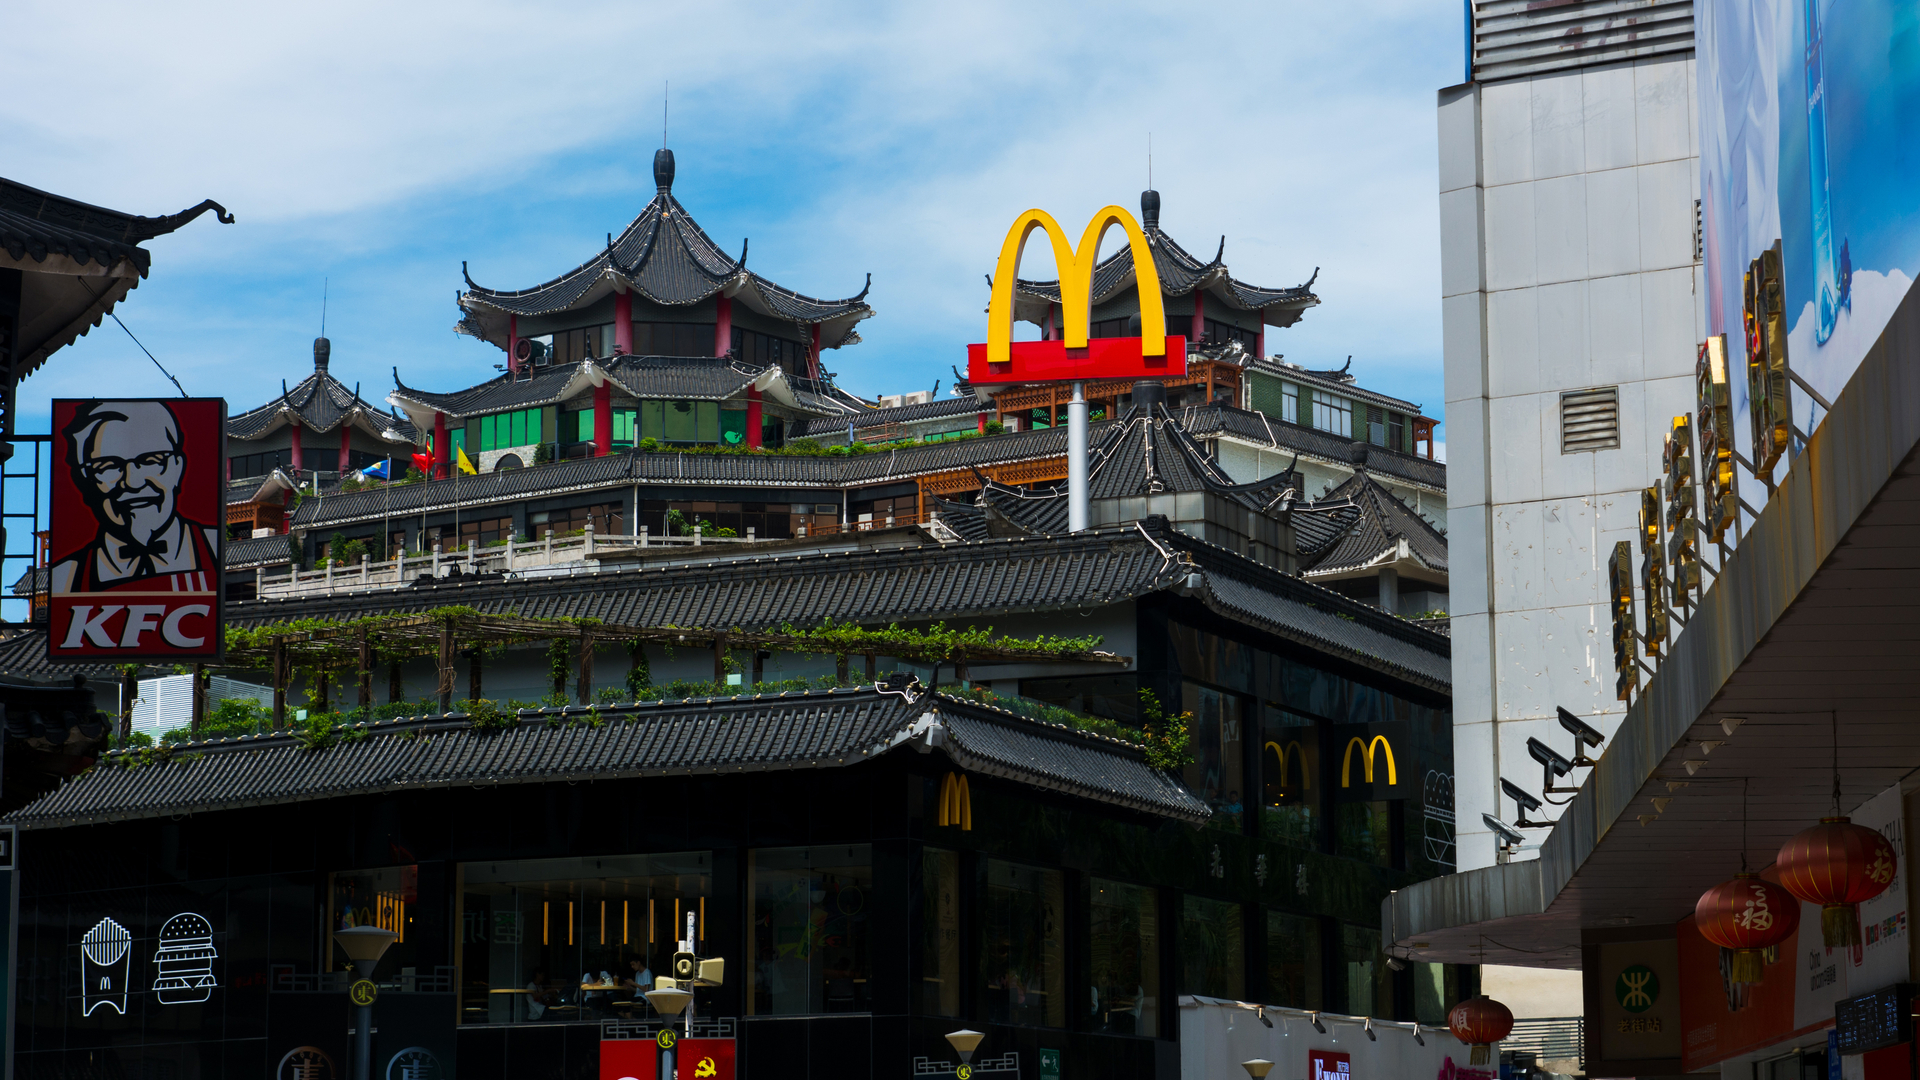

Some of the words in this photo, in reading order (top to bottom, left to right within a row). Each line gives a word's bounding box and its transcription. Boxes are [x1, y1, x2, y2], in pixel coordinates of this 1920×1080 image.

[59, 603, 211, 649] KFC
[1741, 884, 1774, 931] 福
[1617, 1017, 1662, 1034] 老街站
